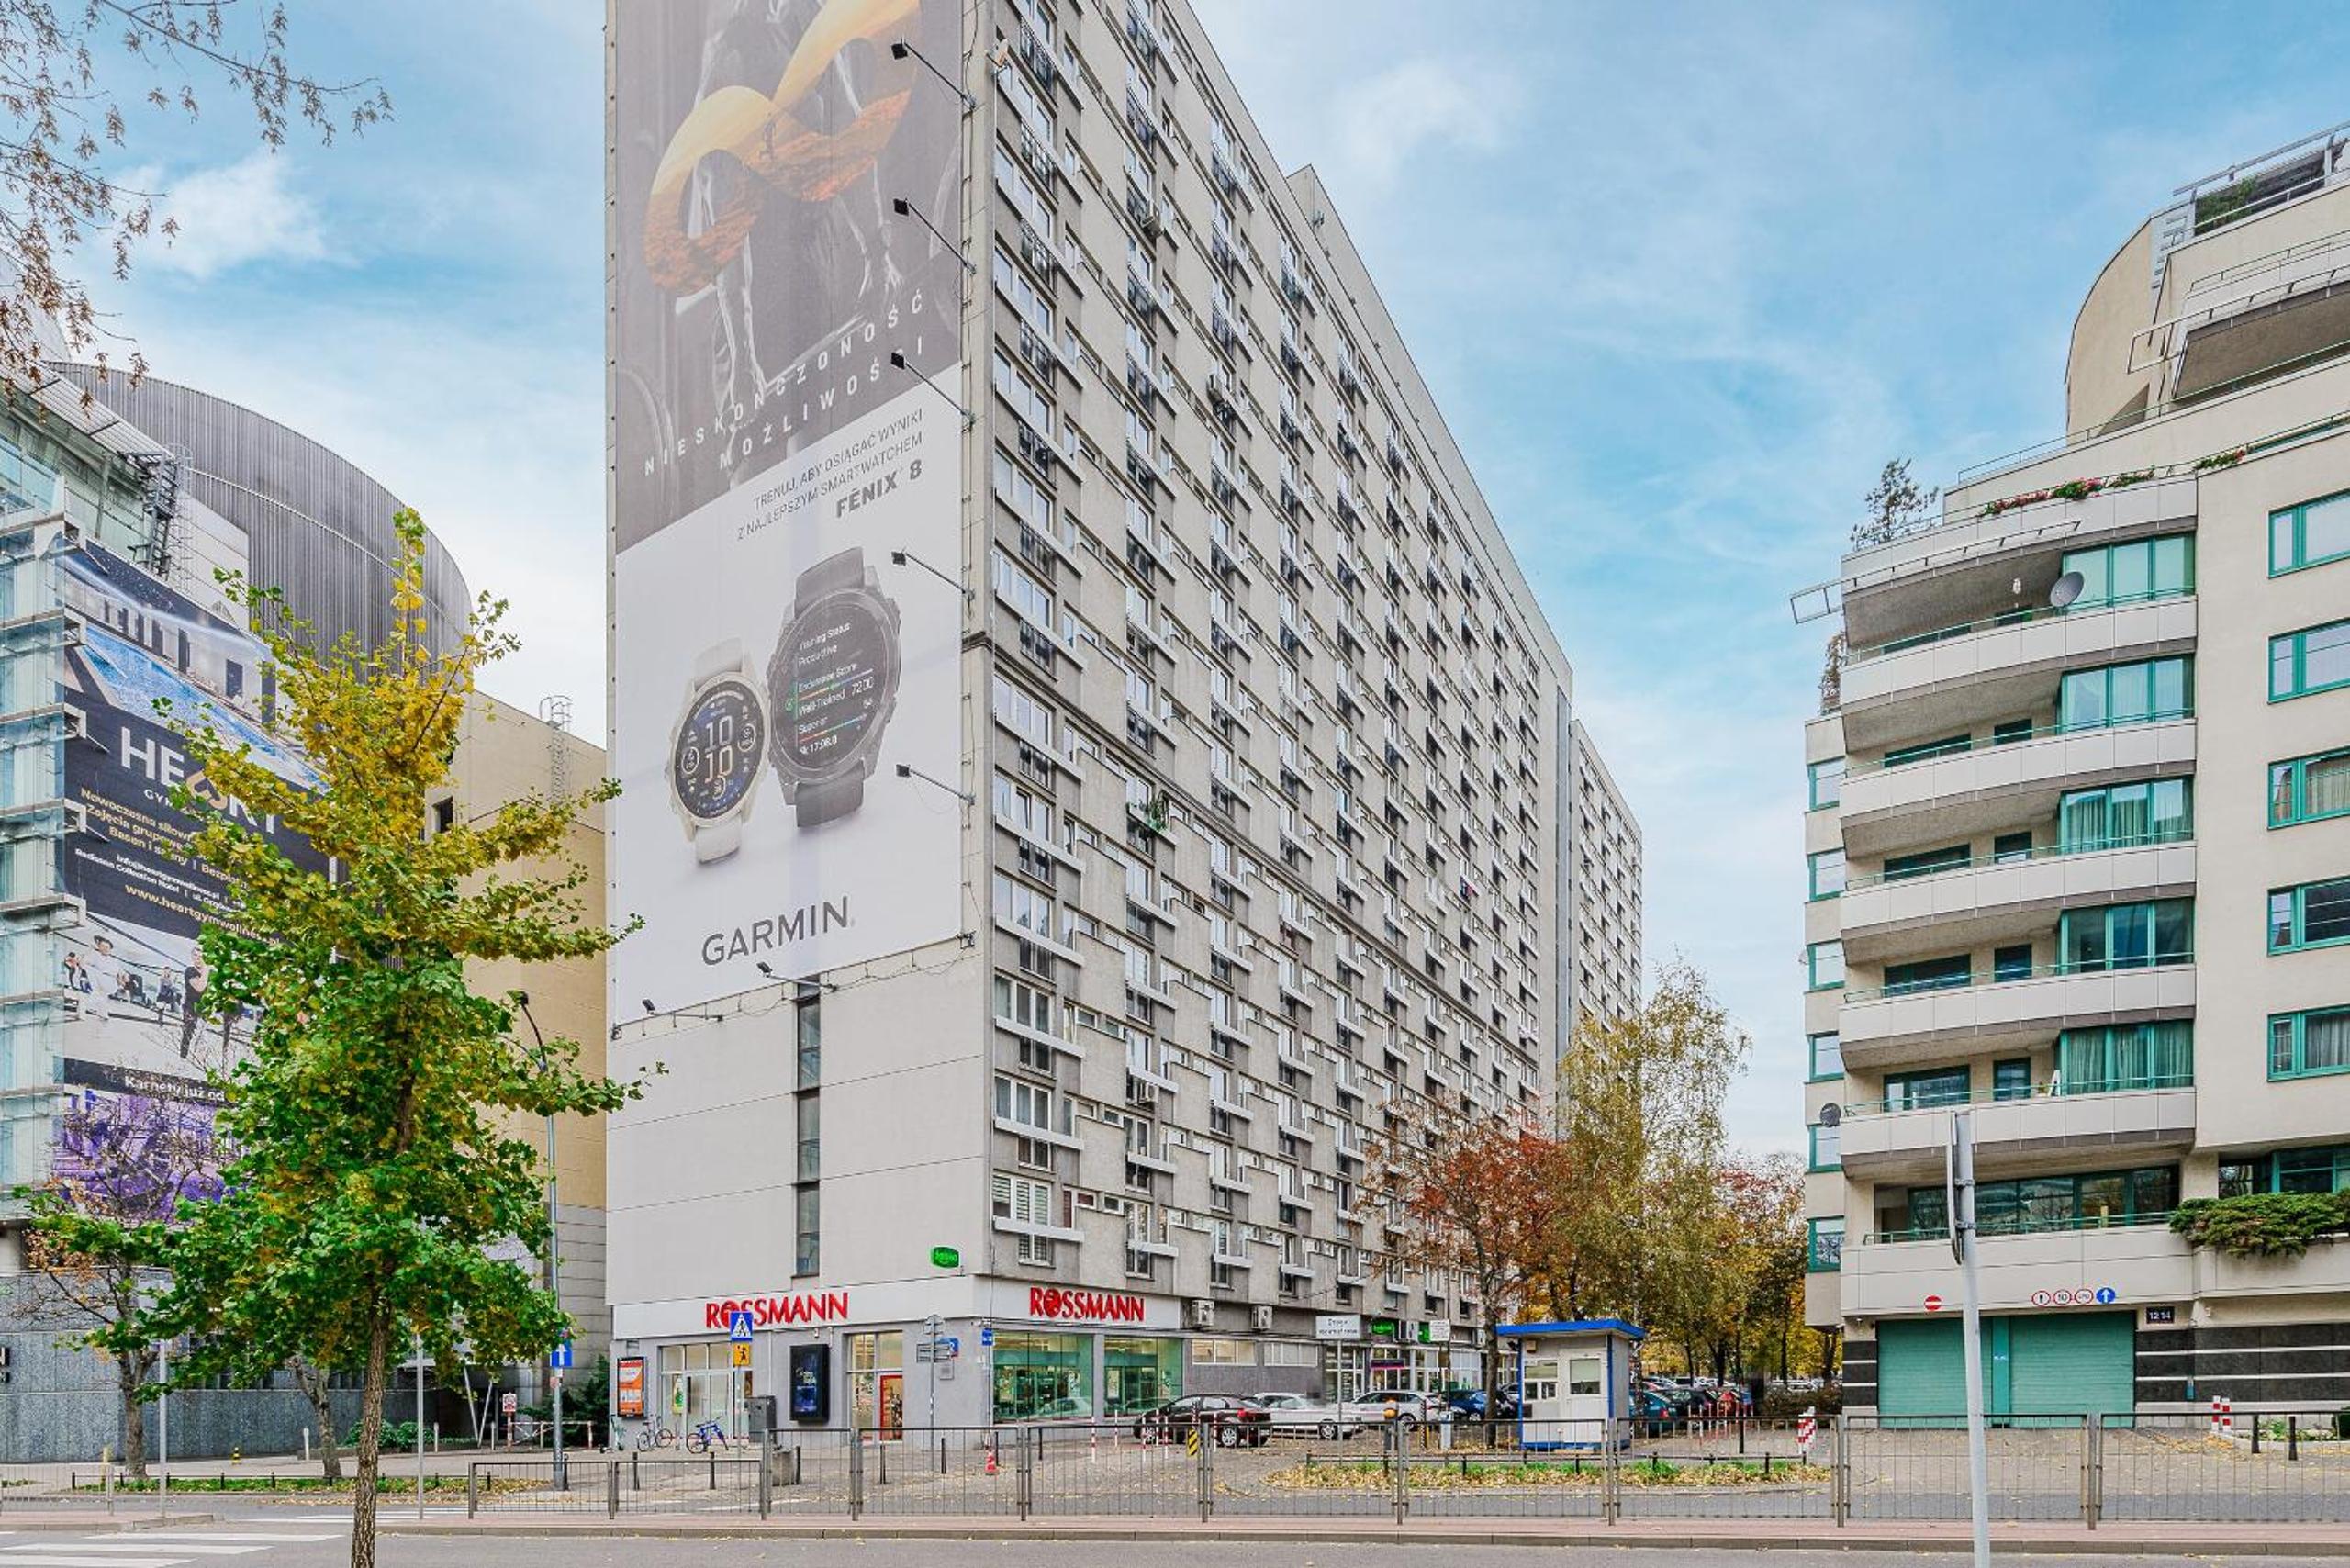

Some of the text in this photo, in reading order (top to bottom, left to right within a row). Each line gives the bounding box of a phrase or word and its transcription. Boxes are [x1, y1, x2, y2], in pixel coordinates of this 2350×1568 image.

[720, 335, 923, 470] MOŻLIWOŚI
[800, 463, 822, 486] ABY
[910, 458, 922, 480] 8
[704, 714, 733, 754] 10
[704, 745, 733, 785] 10
[108, 825, 147, 849] Basen
[154, 846, 189, 866] sany
[701, 894, 849, 966] GARMIN
[1029, 1286, 1146, 1322] ROSSMANN
